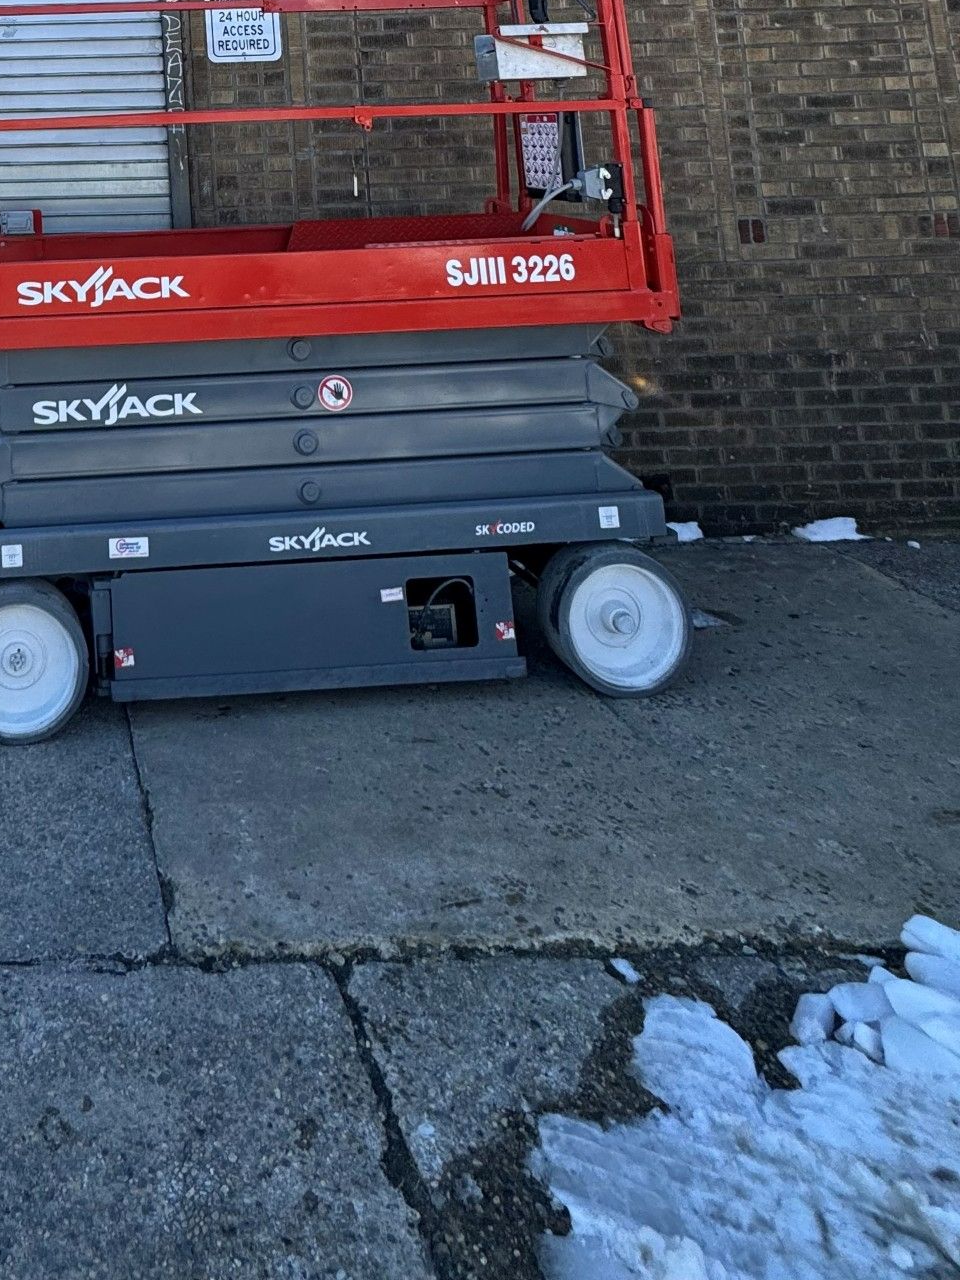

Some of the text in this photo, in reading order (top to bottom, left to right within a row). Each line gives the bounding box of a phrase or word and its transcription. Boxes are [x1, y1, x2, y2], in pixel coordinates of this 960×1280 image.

[219, 10, 265, 22] 24 HOUR
[222, 25, 263, 37] ACCESS
[218, 39, 270, 51] REQUIRED
[445, 253, 576, 287] SJIII 3226
[16, 265, 191, 308] SKYJACK
[32, 383, 203, 426] SKYJACK
[268, 526, 372, 552] SKYJACK
